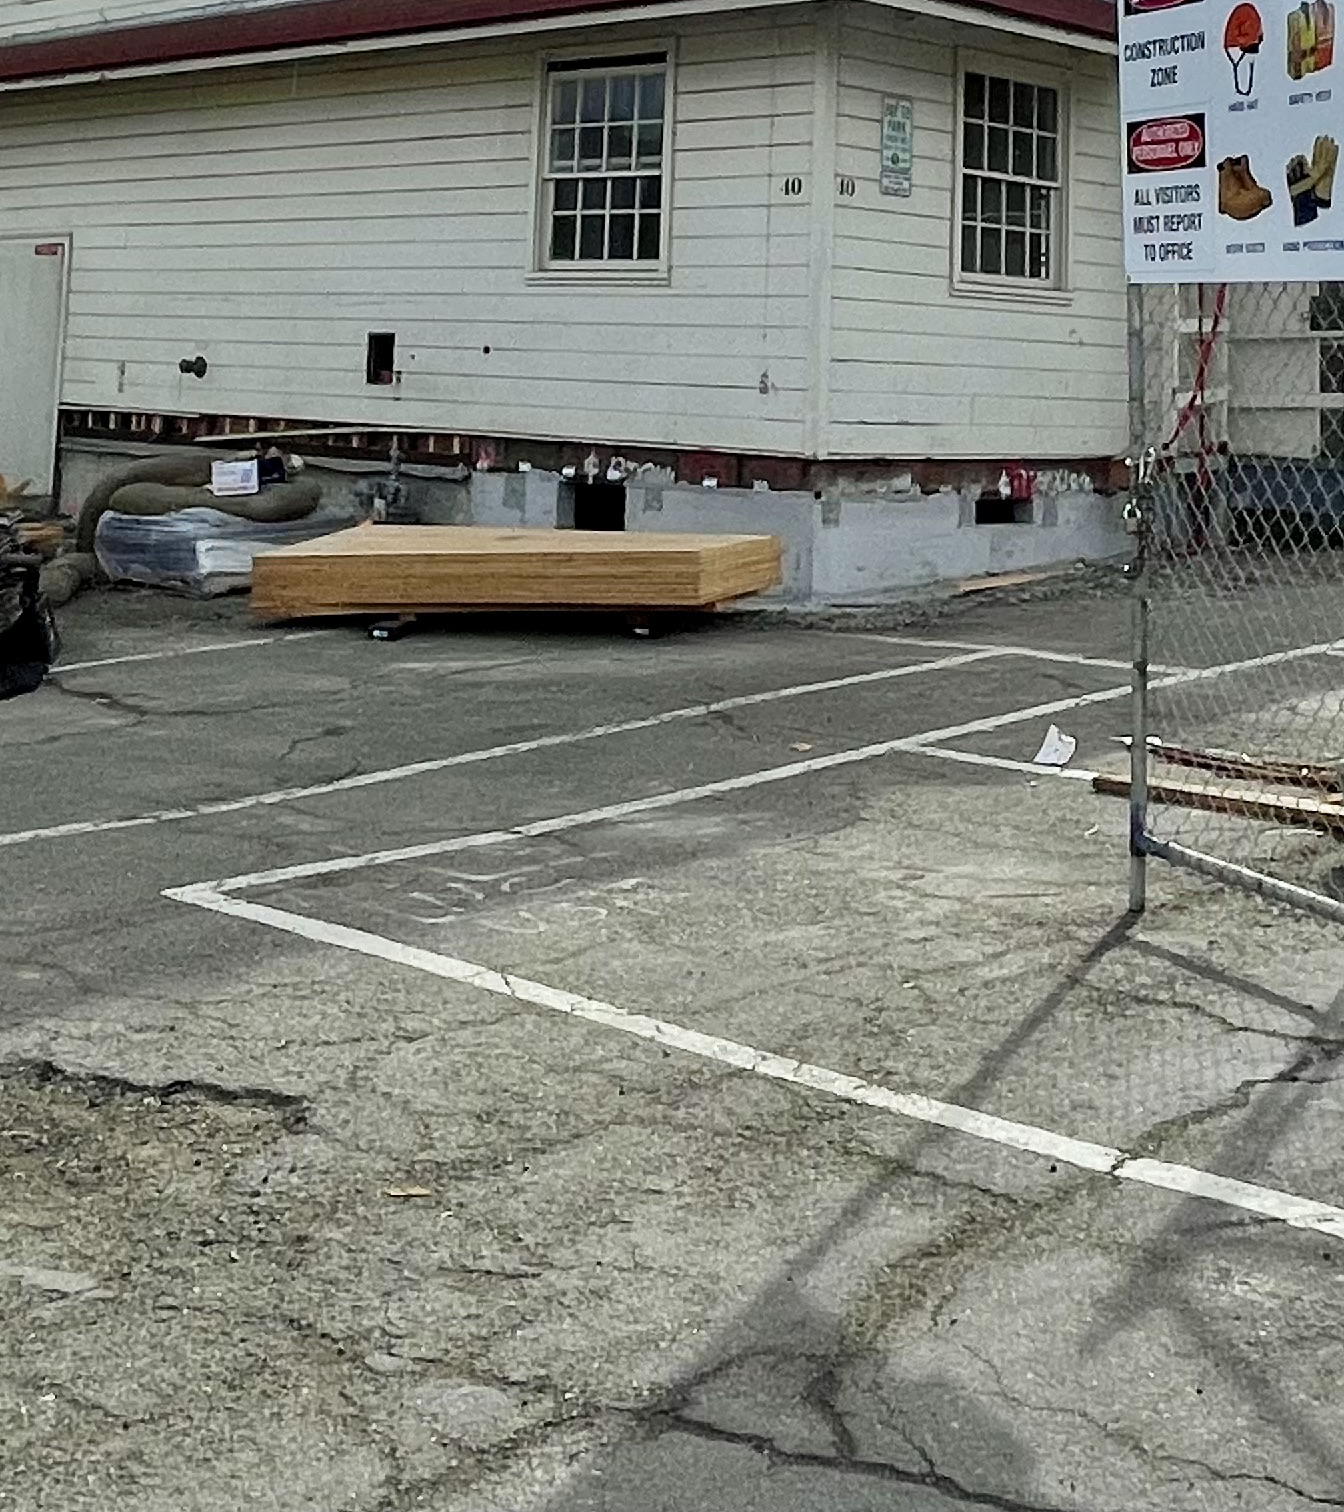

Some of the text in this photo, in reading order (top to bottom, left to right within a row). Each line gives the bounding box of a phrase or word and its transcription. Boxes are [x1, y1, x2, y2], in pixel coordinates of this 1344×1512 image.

[1124, 31, 1205, 62] CONSTRUCTION
[1150, 65, 1178, 88] ZONE
[1134, 183, 1201, 206] ALL VISITORS
[1133, 213, 1203, 234] MUST REPORT
[1143, 241, 1194, 262] TO OFFICE
